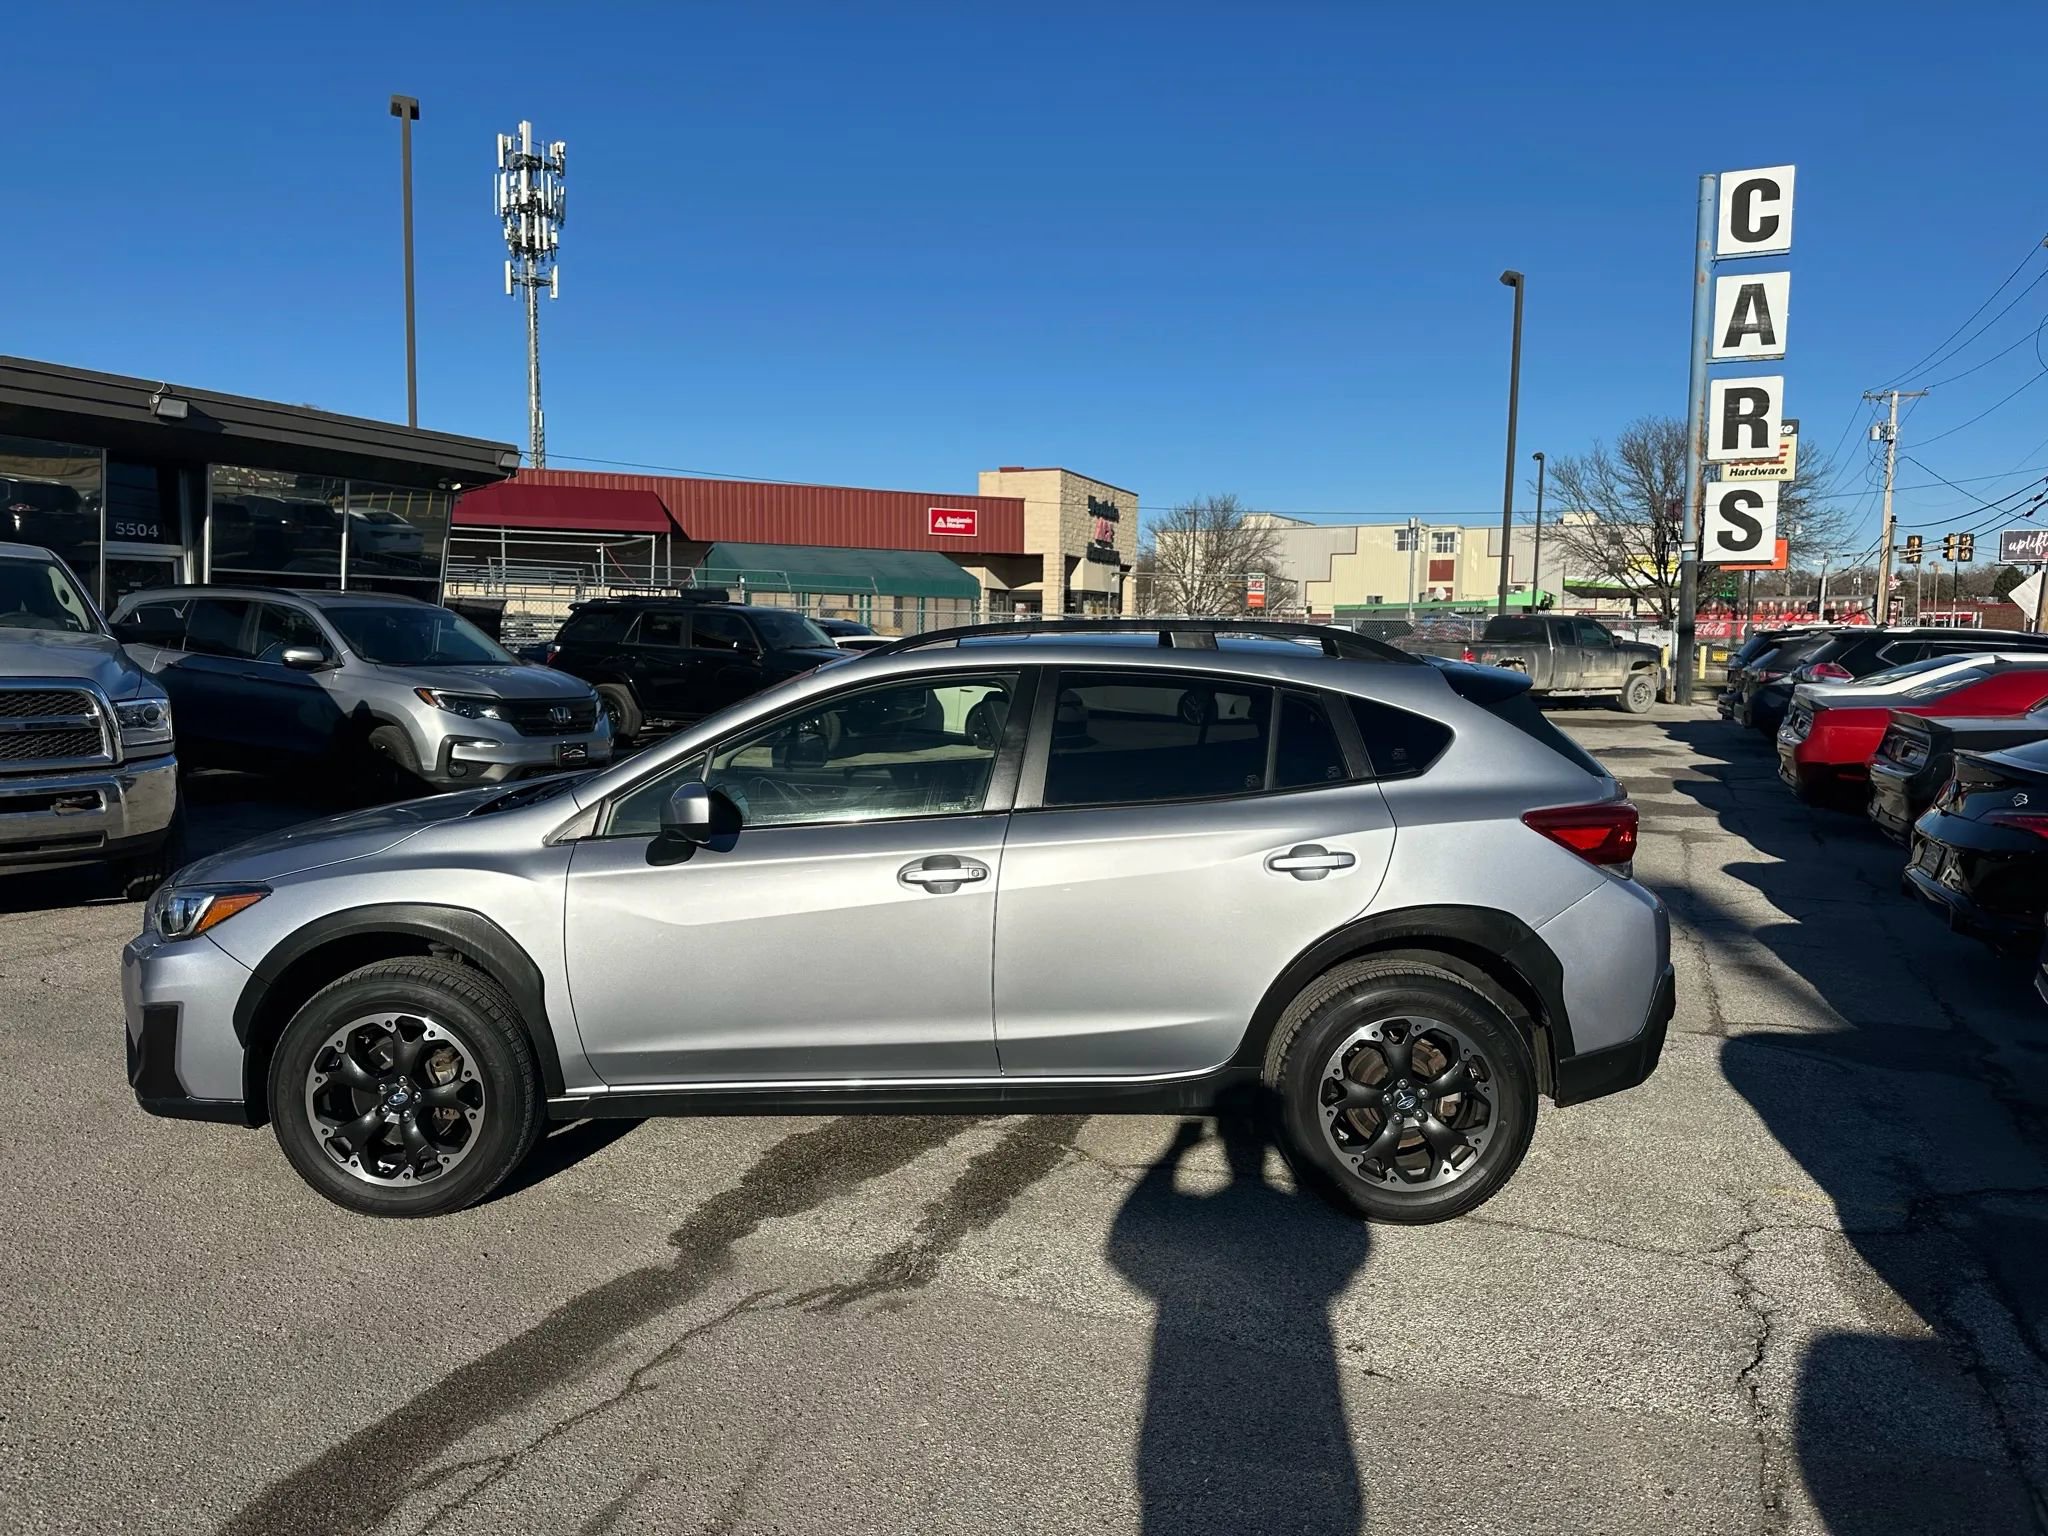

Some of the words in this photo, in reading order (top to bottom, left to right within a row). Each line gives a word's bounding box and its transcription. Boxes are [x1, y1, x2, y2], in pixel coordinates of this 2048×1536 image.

[1716, 177, 1781, 552] CARS
[1729, 466, 1788, 477] Hardware
[115, 521, 159, 537] 5504
